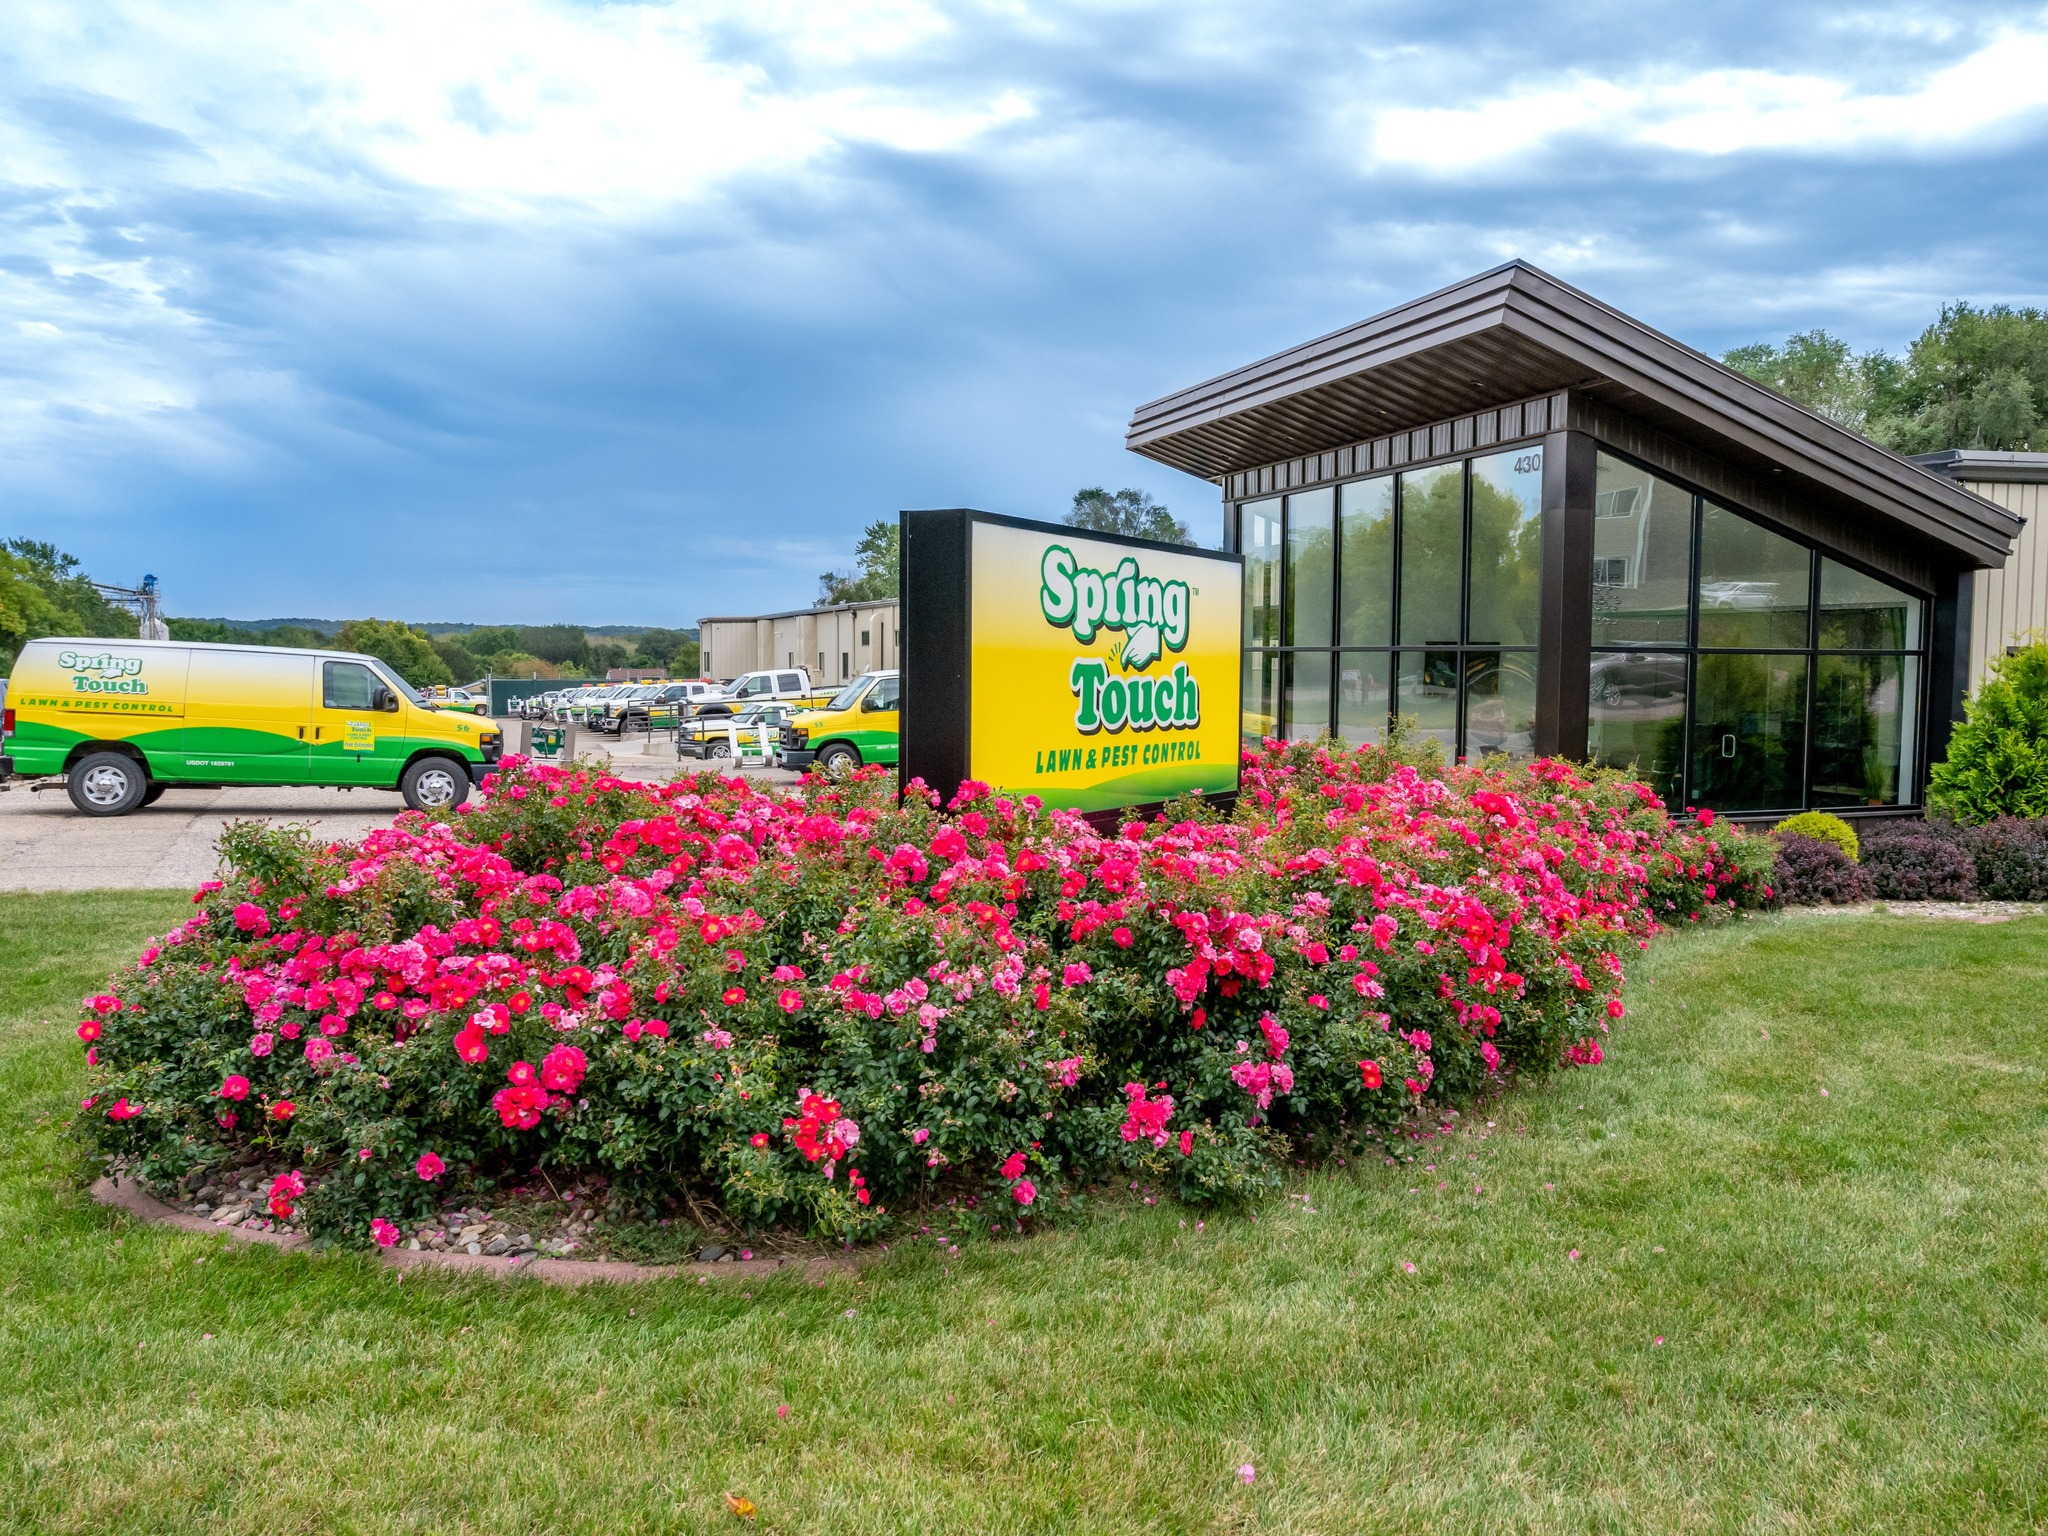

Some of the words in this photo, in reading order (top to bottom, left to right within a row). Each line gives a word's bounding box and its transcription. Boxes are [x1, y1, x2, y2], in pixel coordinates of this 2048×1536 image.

[1514, 454, 1541, 474] 430
[1040, 544, 1190, 653] Spring
[58, 651, 142, 676] Spring
[72, 675, 149, 695] Touch
[1069, 656, 1200, 736] Touch
[20, 698, 58, 707] LAWN
[61, 699, 70, 708] &
[75, 700, 108, 710] PEST
[113, 702, 173, 712] CONTROL
[456, 724, 470, 732] 56
[1035, 748, 1083, 774] LAWN
[1085, 748, 1097, 769] &
[1101, 744, 1138, 768] PEST
[1143, 740, 1201, 765] CONTROL
